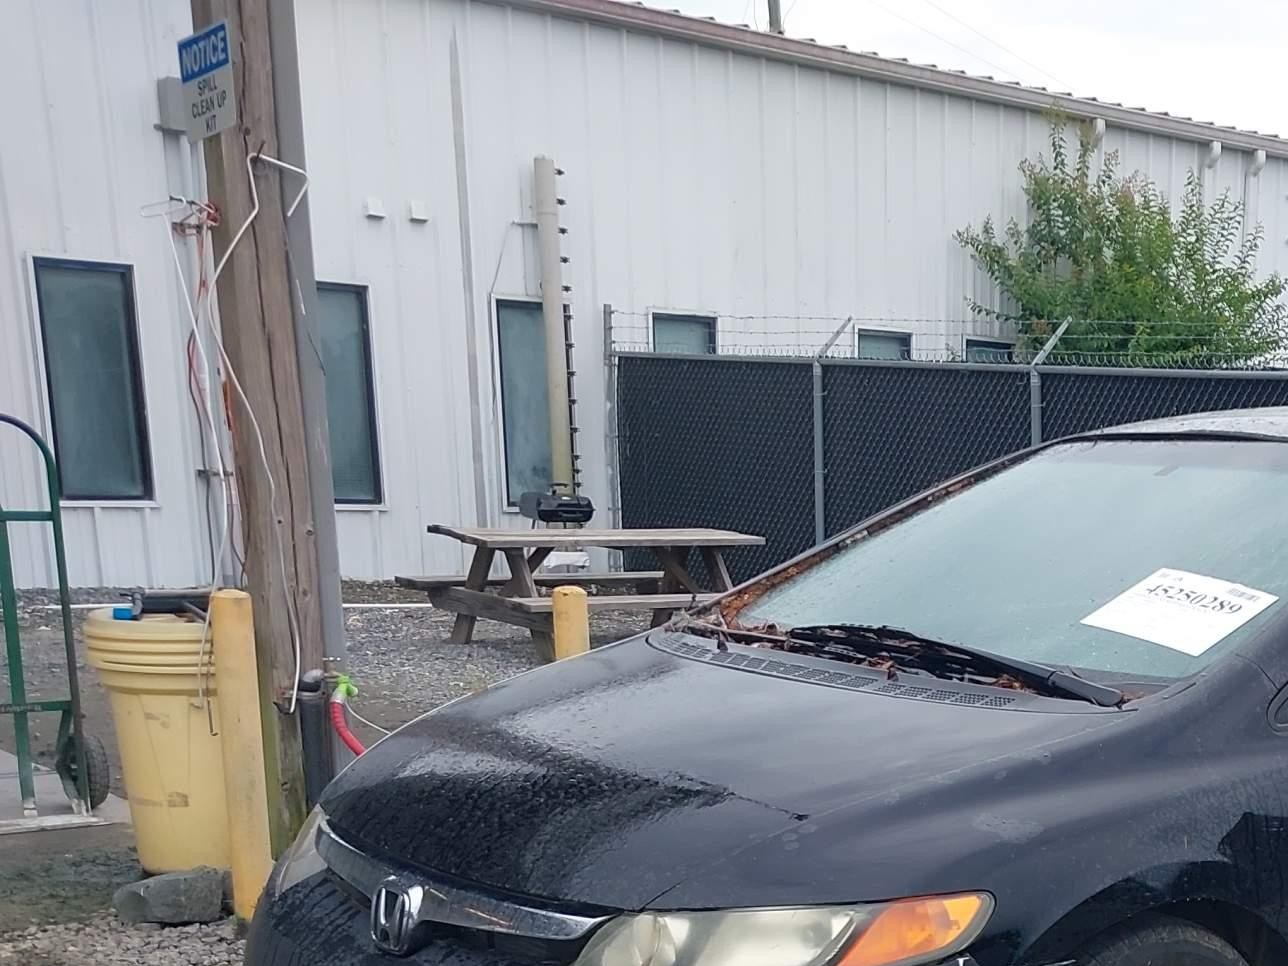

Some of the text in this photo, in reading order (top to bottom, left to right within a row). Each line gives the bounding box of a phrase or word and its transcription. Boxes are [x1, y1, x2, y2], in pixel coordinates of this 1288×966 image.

[182, 30, 226, 76] NOTICE
[197, 74, 218, 97] SPILL
[191, 90, 227, 119] CLEAN UP
[205, 114, 217, 133] KIT
[1145, 584, 1243, 615] 45250289
